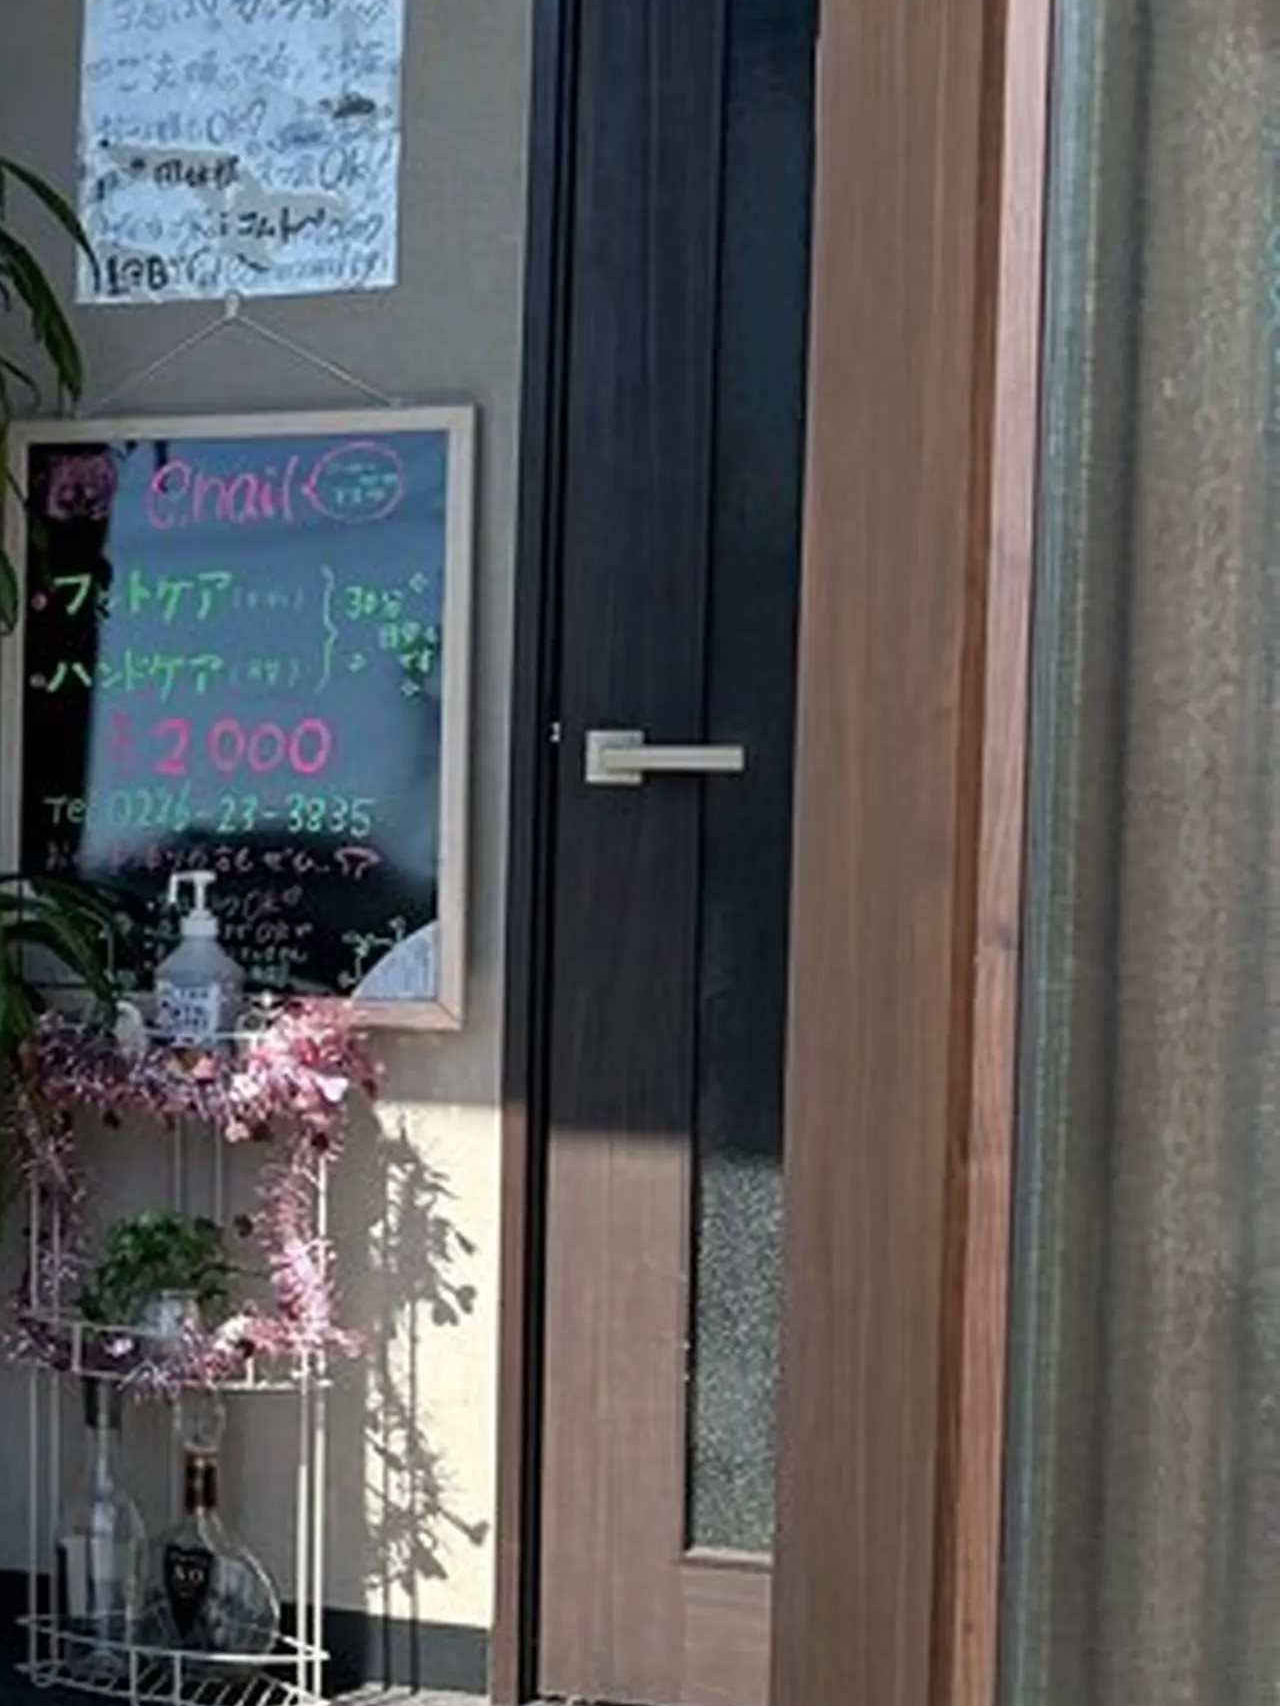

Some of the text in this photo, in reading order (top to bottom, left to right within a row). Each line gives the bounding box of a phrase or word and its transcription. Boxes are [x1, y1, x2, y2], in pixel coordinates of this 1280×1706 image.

[48, 648, 224, 701] ハンドケア
